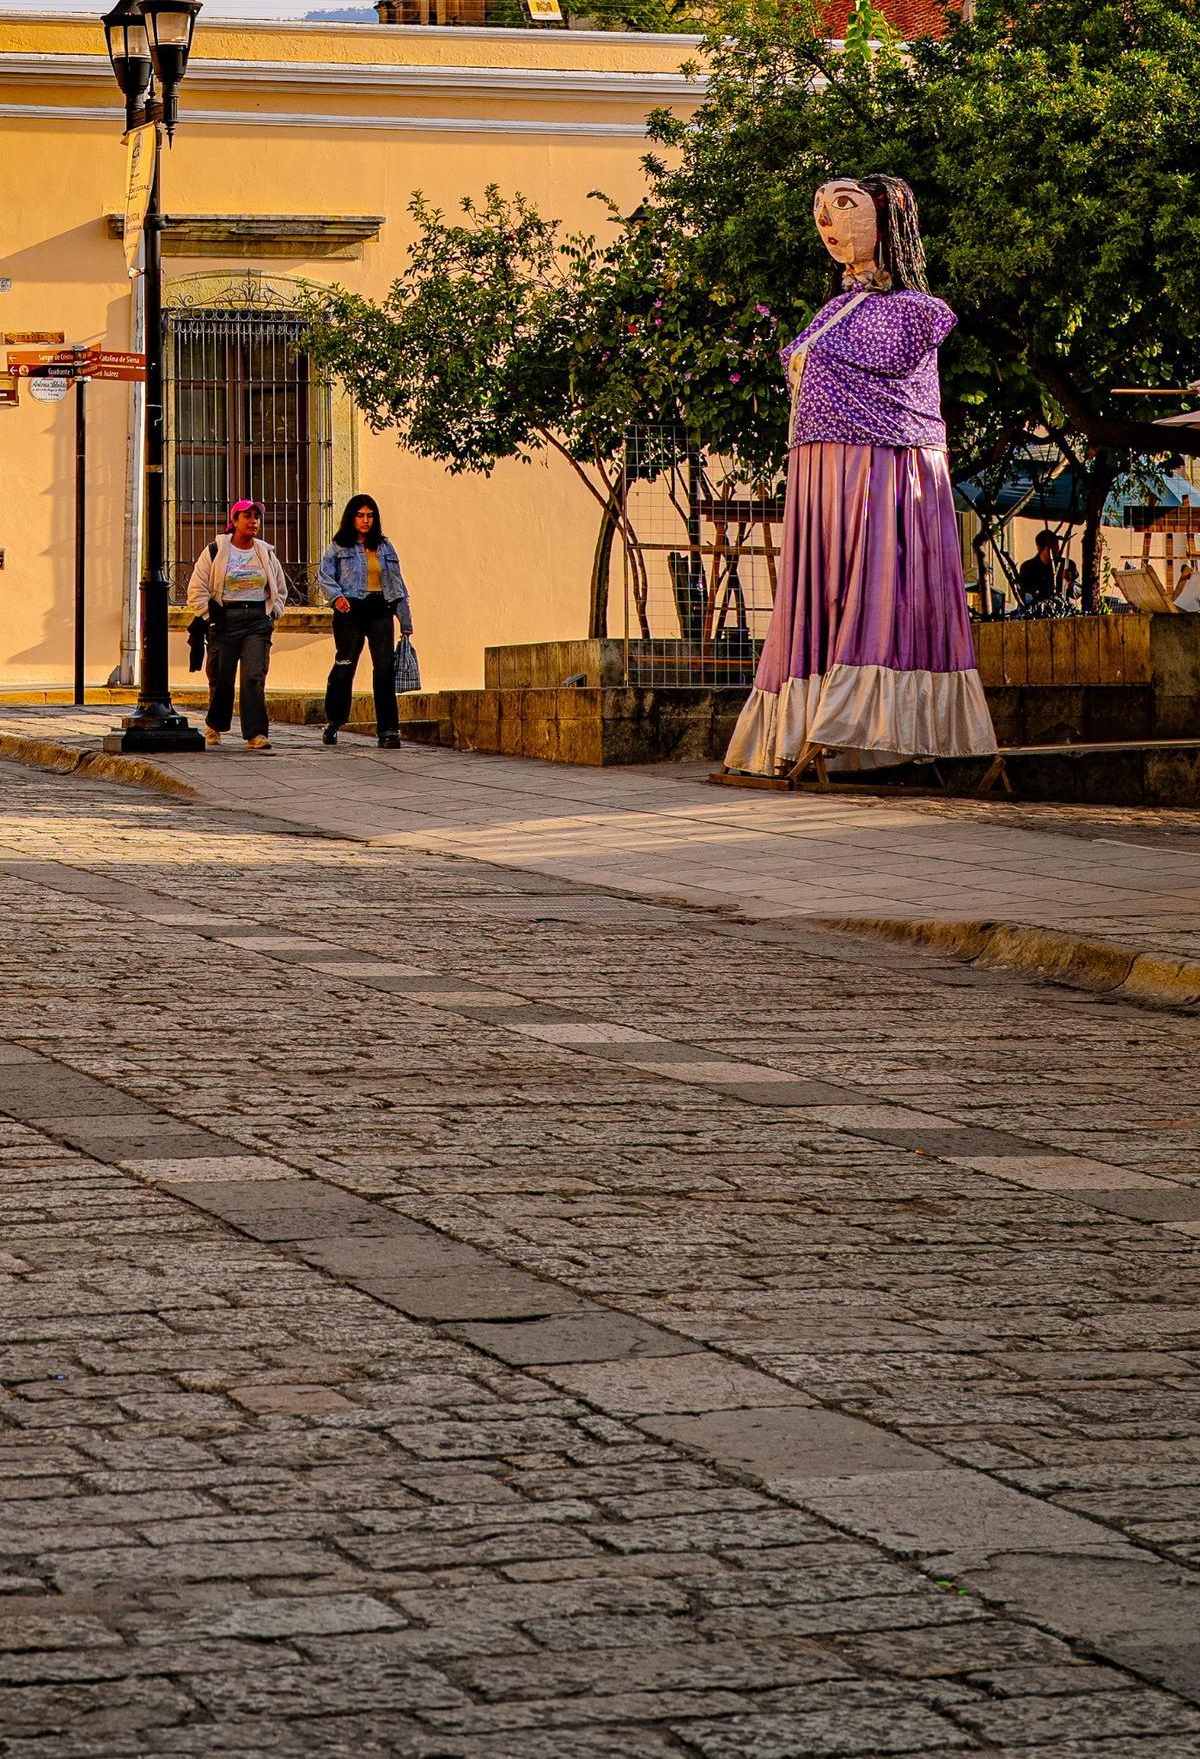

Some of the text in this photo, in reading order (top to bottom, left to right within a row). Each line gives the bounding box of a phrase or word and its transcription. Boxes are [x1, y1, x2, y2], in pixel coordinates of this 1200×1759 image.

[119, 355, 126, 363] de
[48, 367, 70, 375] Cuadrante
[104, 369, 119, 377] Juárez
